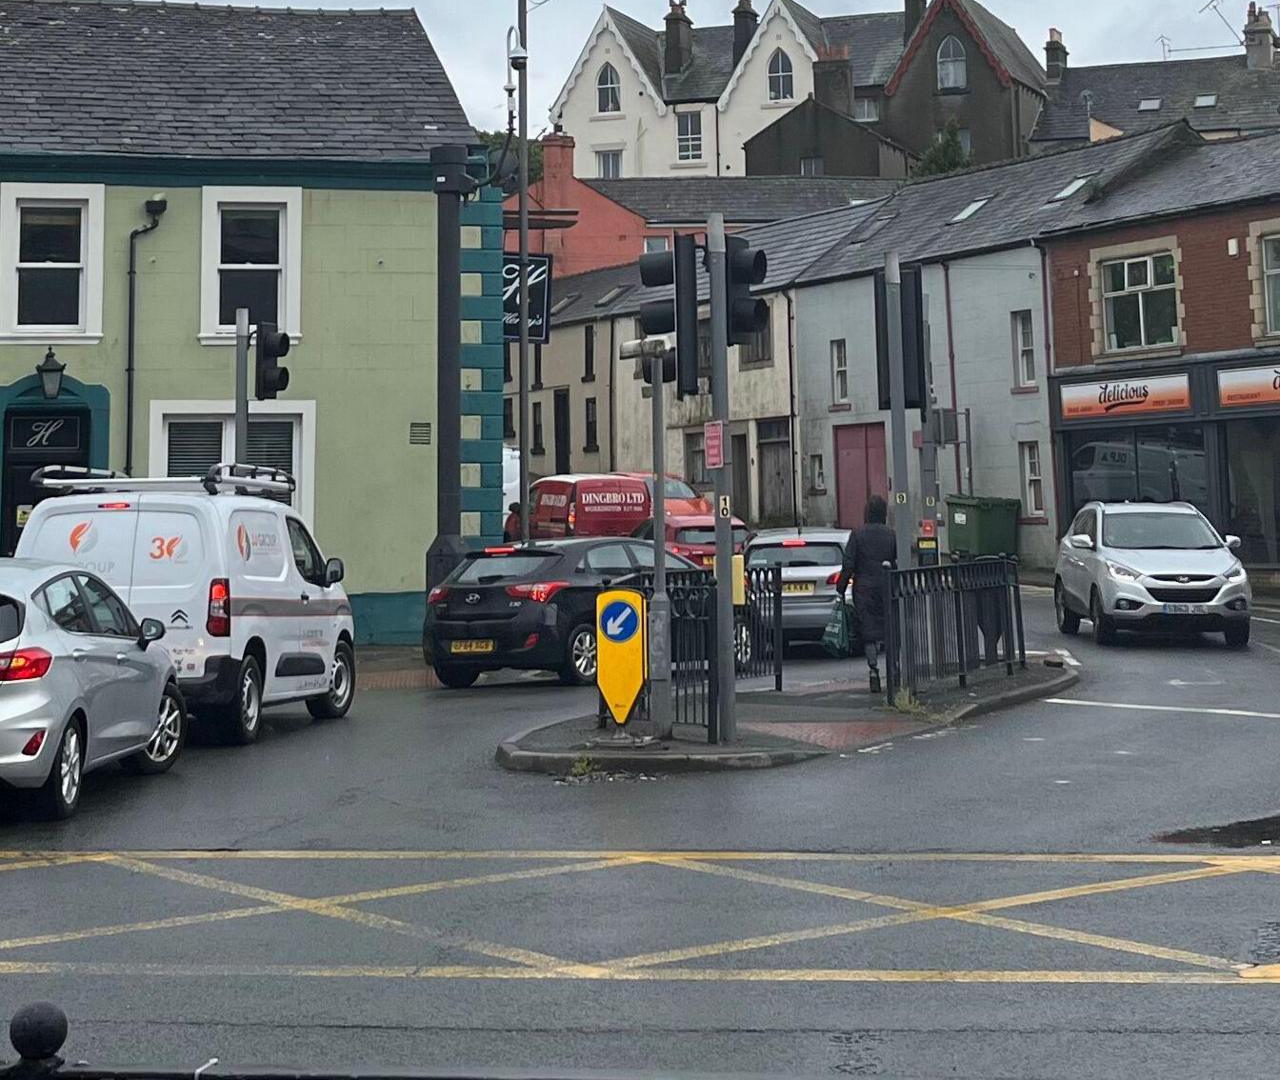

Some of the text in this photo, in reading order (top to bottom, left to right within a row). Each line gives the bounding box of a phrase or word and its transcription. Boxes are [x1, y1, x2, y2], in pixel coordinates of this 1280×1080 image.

[1098, 383, 1150, 407] delicious
[26, 419, 64, 447] H
[581, 492, 625, 505] DINGBRO
[626, 492, 645, 504] LTD
